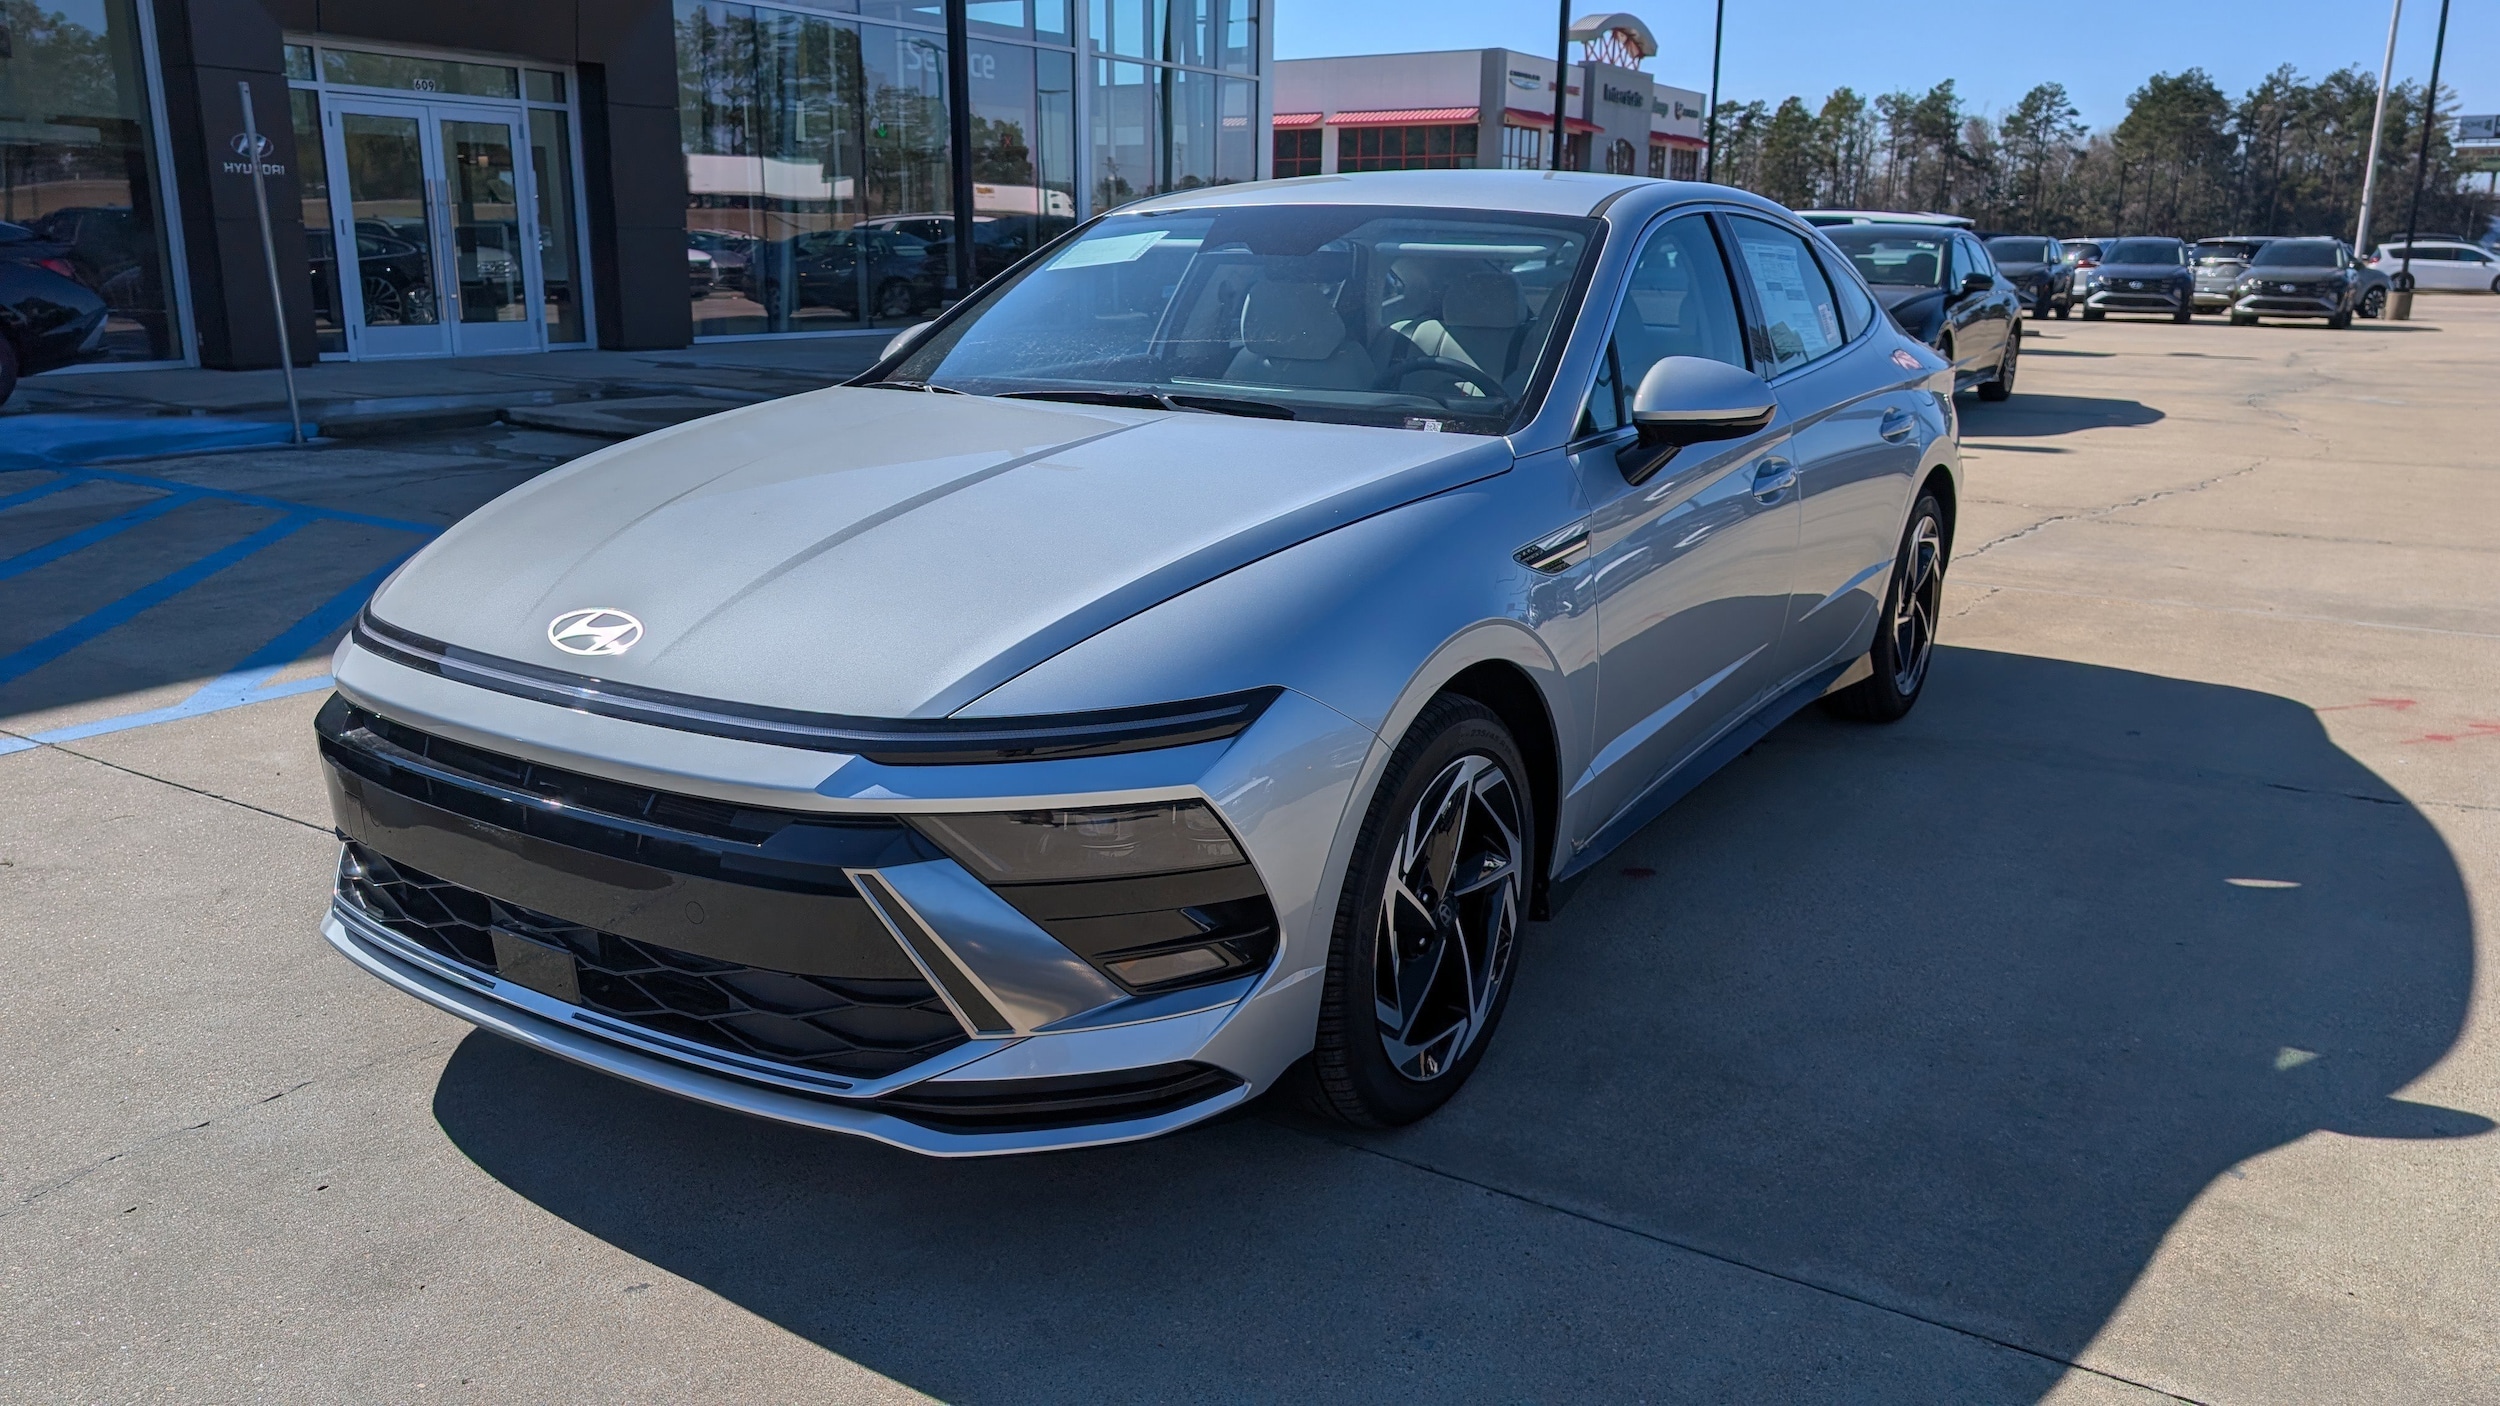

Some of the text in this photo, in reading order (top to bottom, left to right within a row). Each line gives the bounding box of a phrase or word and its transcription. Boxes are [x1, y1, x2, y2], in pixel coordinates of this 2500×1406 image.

[906, 37, 995, 79] Sece
[415, 80, 435, 91] 609
[223, 162, 286, 176] HYUDAI
